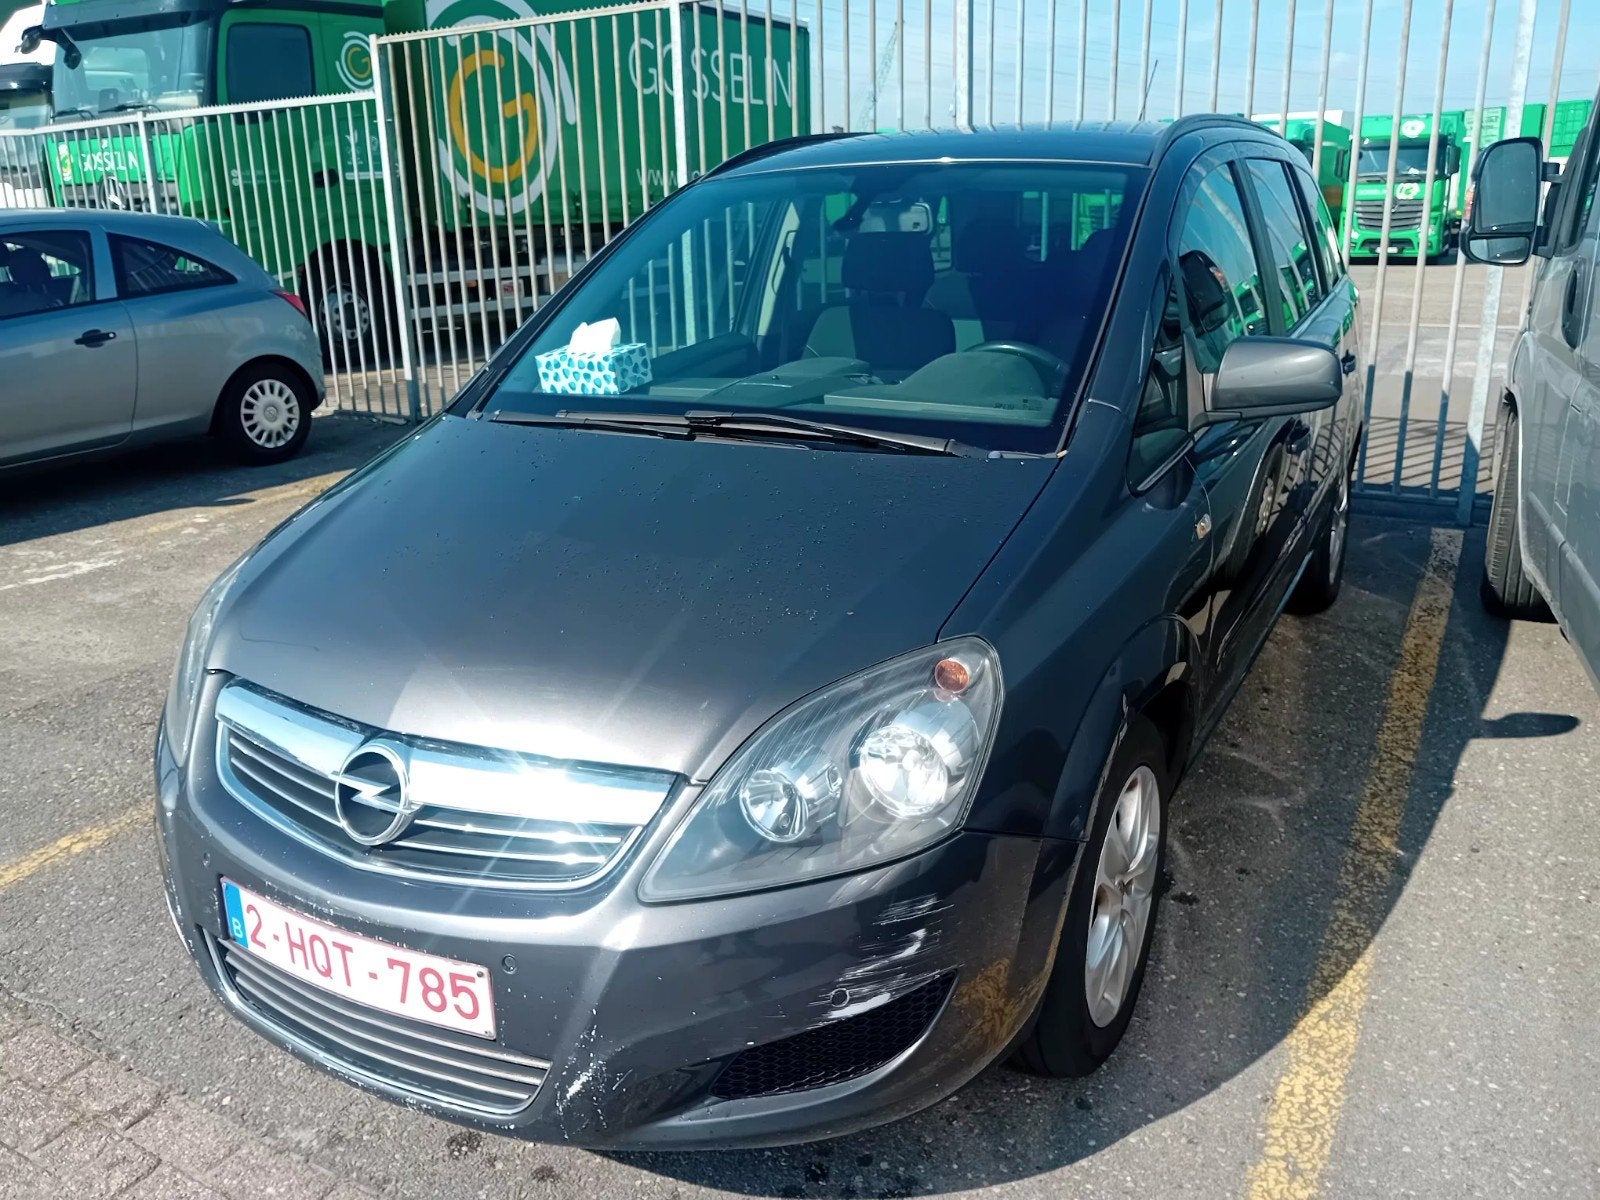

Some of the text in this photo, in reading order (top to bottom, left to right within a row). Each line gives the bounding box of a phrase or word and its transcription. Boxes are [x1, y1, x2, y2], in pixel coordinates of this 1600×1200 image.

[628, 37, 793, 108] GSSELN
[80, 151, 140, 172] GOSSELN
[230, 918, 244, 938] B
